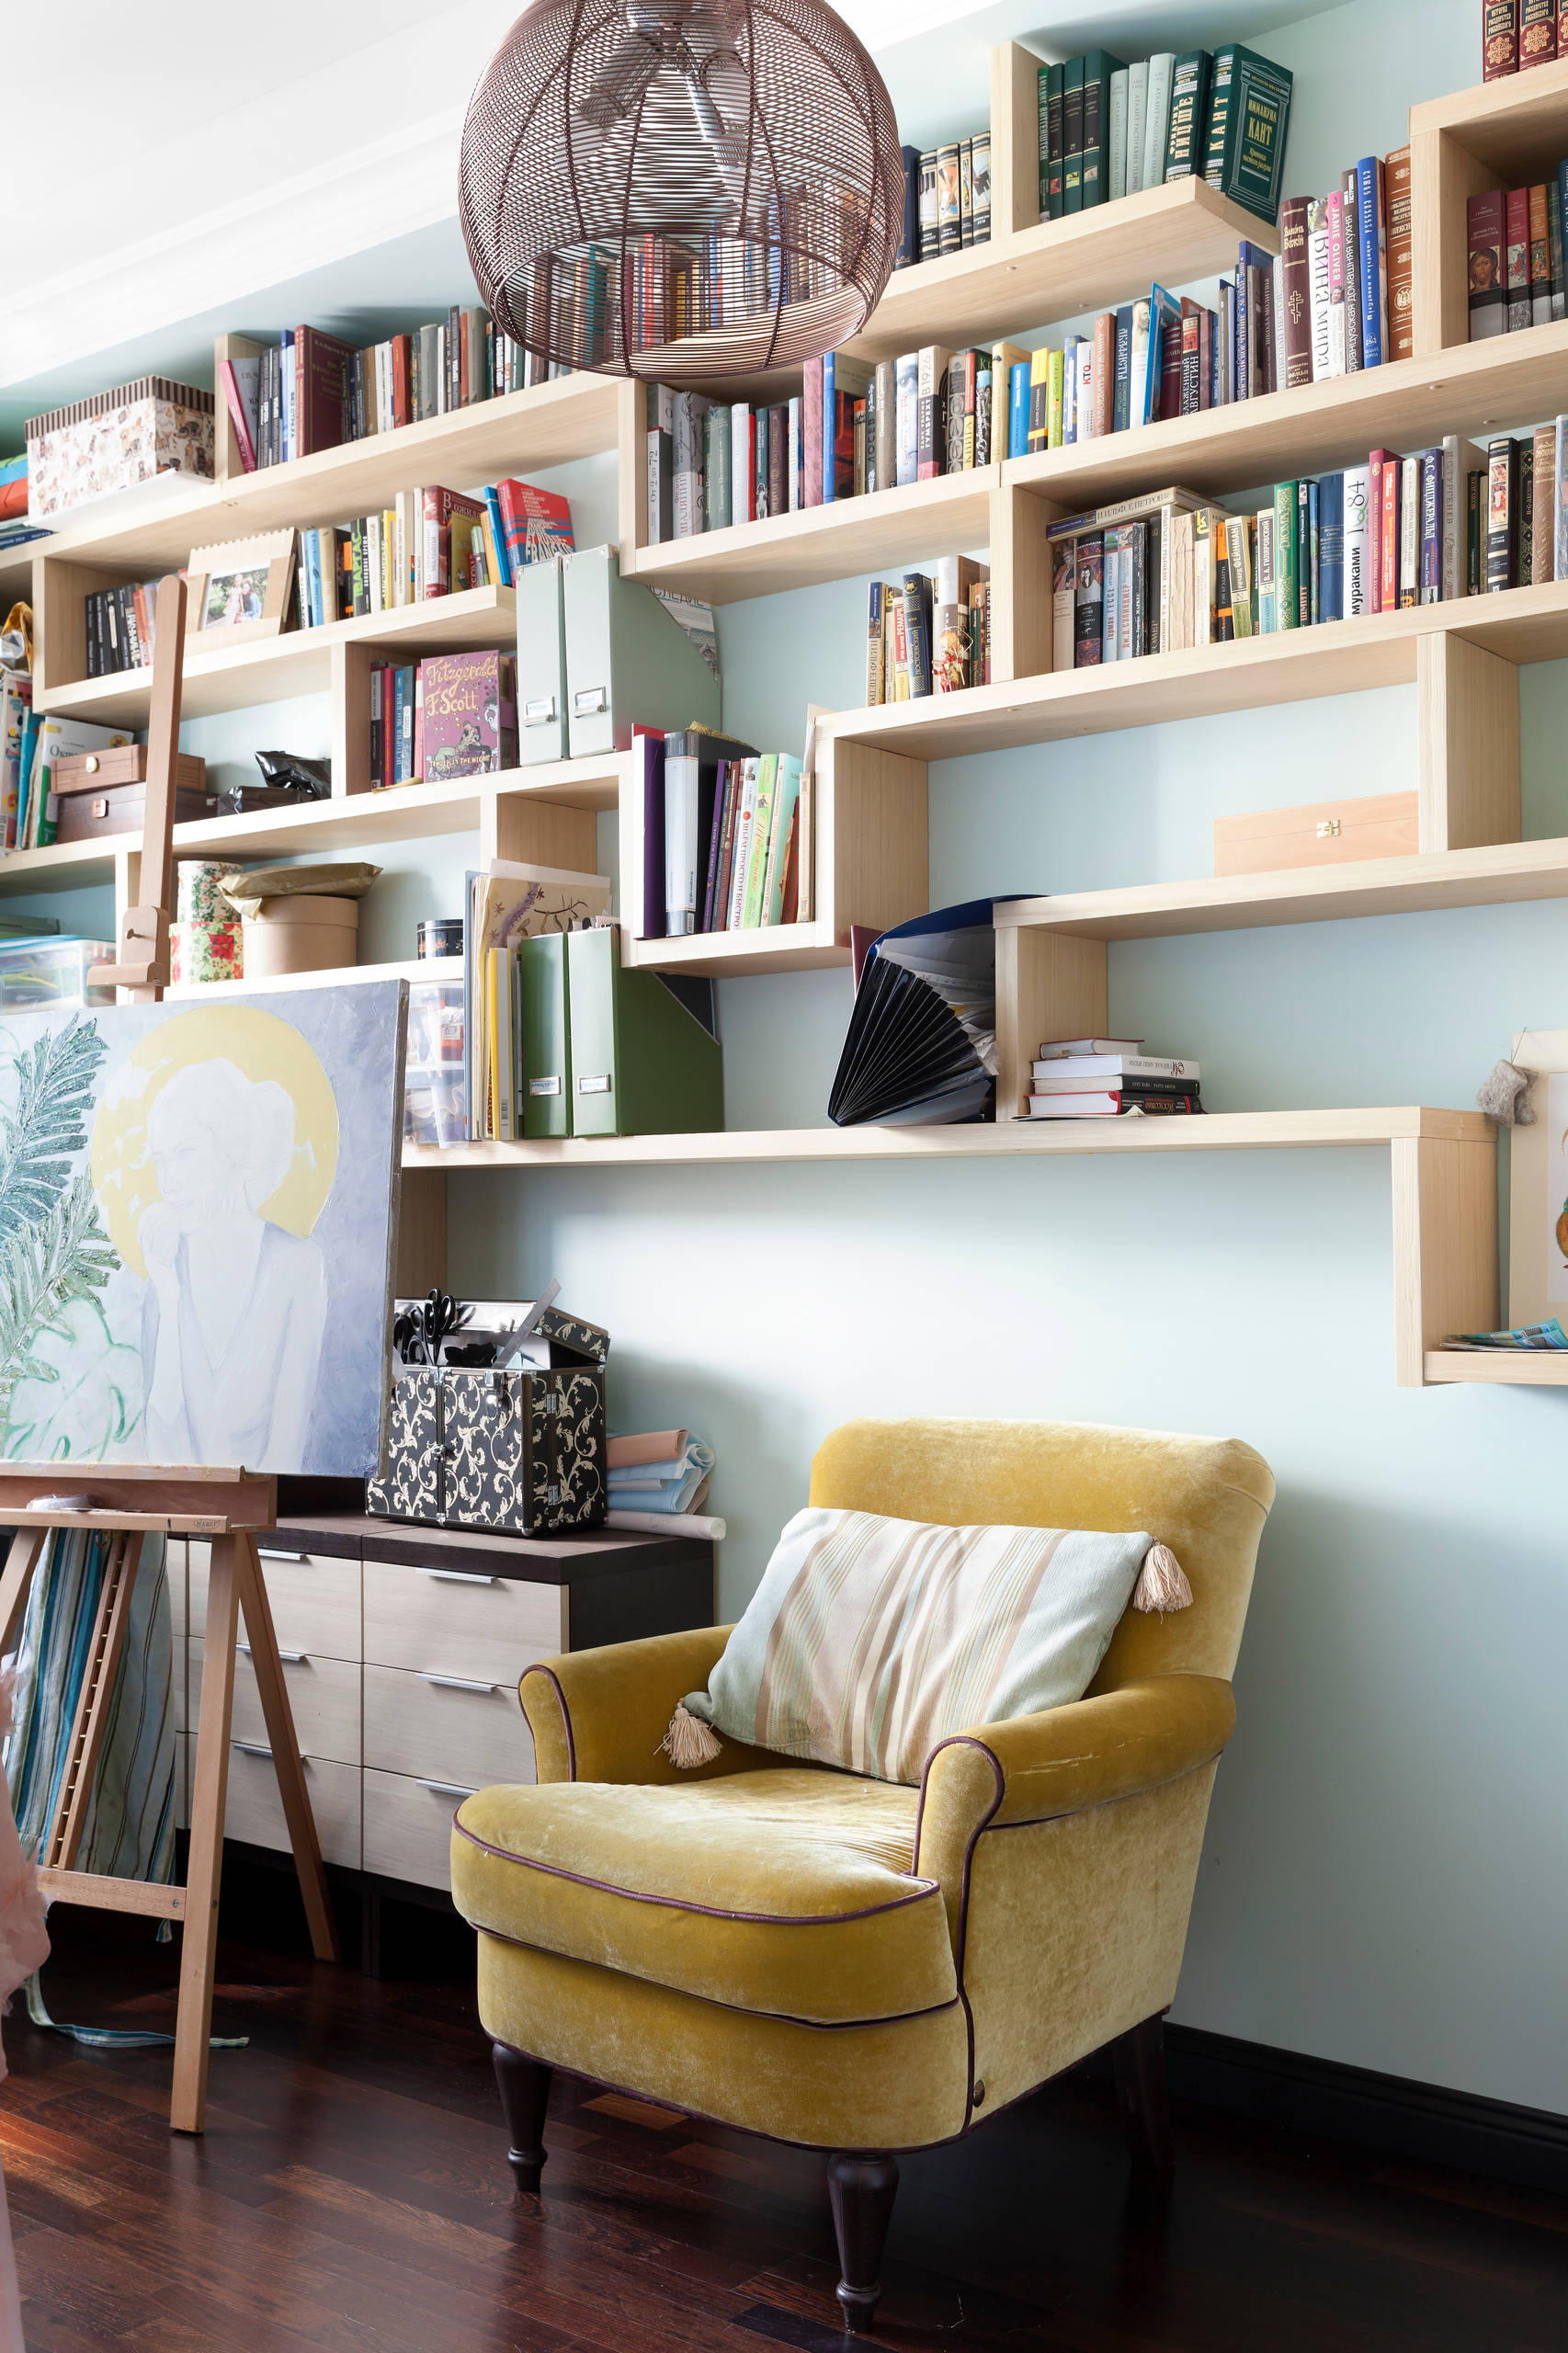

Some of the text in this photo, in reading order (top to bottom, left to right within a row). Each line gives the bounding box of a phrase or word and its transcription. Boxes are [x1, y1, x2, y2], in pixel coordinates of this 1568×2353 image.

[1175, 97, 1194, 160] НИЦШЕ
[1210, 97, 1229, 152] КАНТ
[1248, 117, 1273, 146] КАНТ
[1331, 208, 1341, 283] JAMIE OLIVER
[1345, 215, 1355, 244] кухня
[1346, 246, 1357, 303] домашняя
[1264, 278, 1273, 346] ШКОЛА МОЛИТВЫ
[1117, 327, 1129, 381] АКАФИСТЫ
[1314, 309, 1329, 368] мира
[1083, 364, 1091, 385] КТО
[1190, 356, 1199, 415] АВГУСТИН
[868, 417, 876, 463] ЛОСЕВ
[924, 398, 932, 449] ГУМБРЕХТ
[648, 449, 658, 466] 72
[678, 472, 689, 534] ШАЛЯПИН
[1424, 474, 1436, 540] ФИЦДЖЕРАЛЬД
[1446, 472, 1454, 525] ТУРГЕНЕВ
[1230, 527, 1243, 568] ФЕЙНМАН
[1262, 519, 1271, 566] ГИЛЯРОВСКИЙ
[1121, 584, 1131, 627] СЭЛИНДЖЕР
[1300, 585, 1309, 622] ШМИТТ
[1350, 546, 1366, 616] мураками
[895, 607, 905, 636] РЕМАРК
[1105, 587, 1115, 641] Герман ГЕССЕ
[426, 657, 499, 694] Fitzgerald
[912, 629, 922, 676] ДОСТОЕВСКИЙ
[395, 692, 403, 766] ИСТОРИЯ МОСКВЫ
[460, 756, 472, 766] THE
[737, 850, 747, 883] ПРОСТО
[733, 892, 743, 927] БЫСТРО
